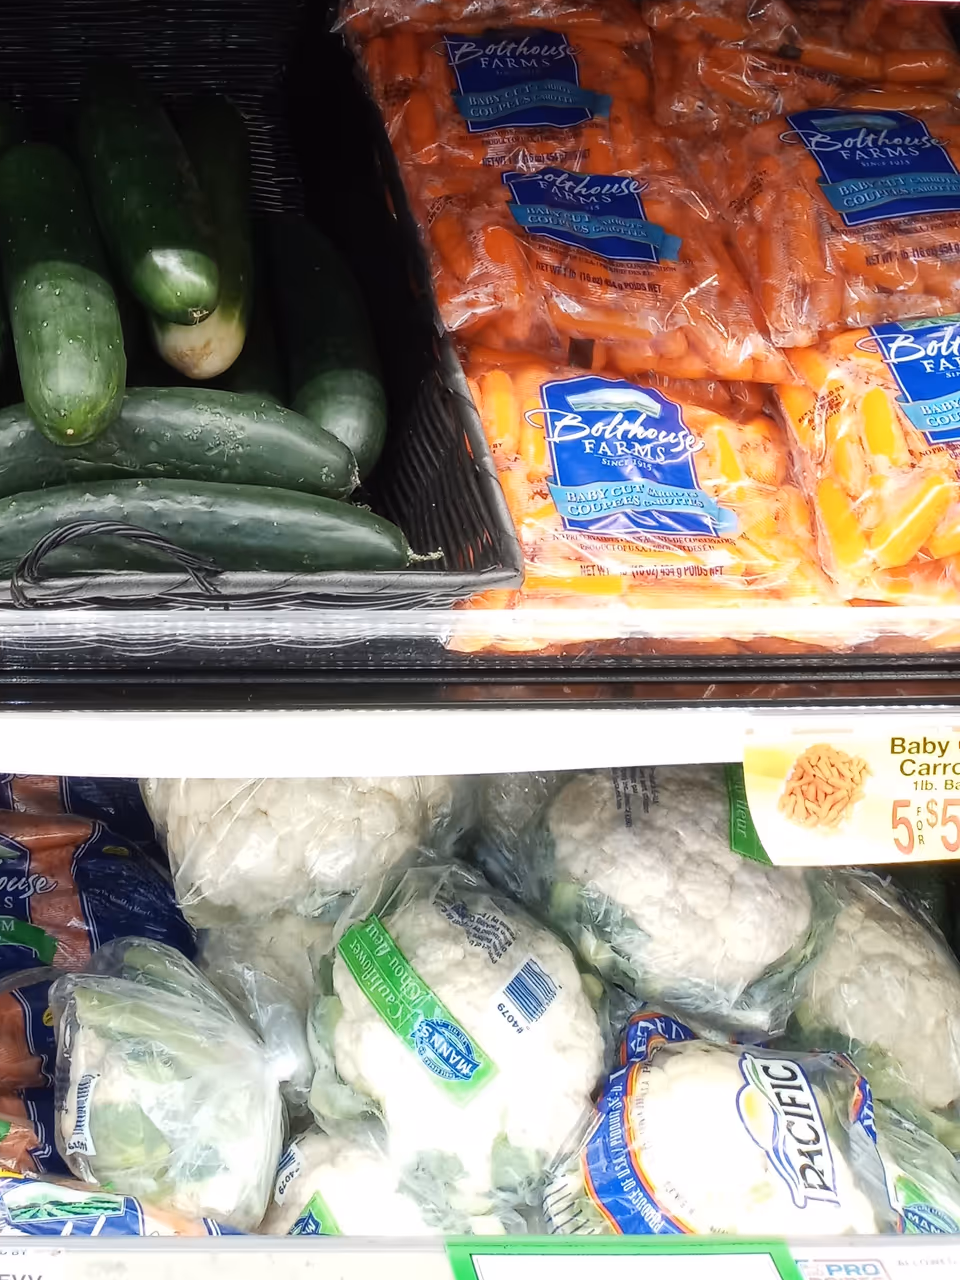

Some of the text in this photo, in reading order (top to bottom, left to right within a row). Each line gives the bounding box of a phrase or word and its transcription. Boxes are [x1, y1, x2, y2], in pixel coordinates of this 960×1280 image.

[431, 36, 586, 66] Bolthouse
[480, 57, 551, 69] FARMS
[468, 94, 501, 107] BABY
[779, 128, 950, 152] Bolthouse
[839, 146, 921, 161] FARMS
[520, 171, 650, 196] olthouse
[539, 179, 612, 205] FARMS
[838, 181, 875, 197] BABY
[623, 282, 647, 293] POIDS
[647, 284, 662, 294] NET
[524, 407, 706, 453] Bolthouse
[582, 439, 666, 462] FARMS
[601, 458, 653, 471] SINCE 1915
[565, 487, 609, 504] BABY
[611, 484, 645, 499] CUT
[683, 565, 708, 577] POIDS
[890, 736, 950, 758] Baby
[913, 780, 937, 791] 1lb.
[891, 800, 915, 855] 5
[349, 938, 404, 1019] Cauliflower
[497, 1003, 524, 1034] #4079
[762, 1063, 830, 1192] PACIFIC
[621, 1177, 665, 1232] PRODUCE OF
[825, 1263, 881, 1276] PRO
